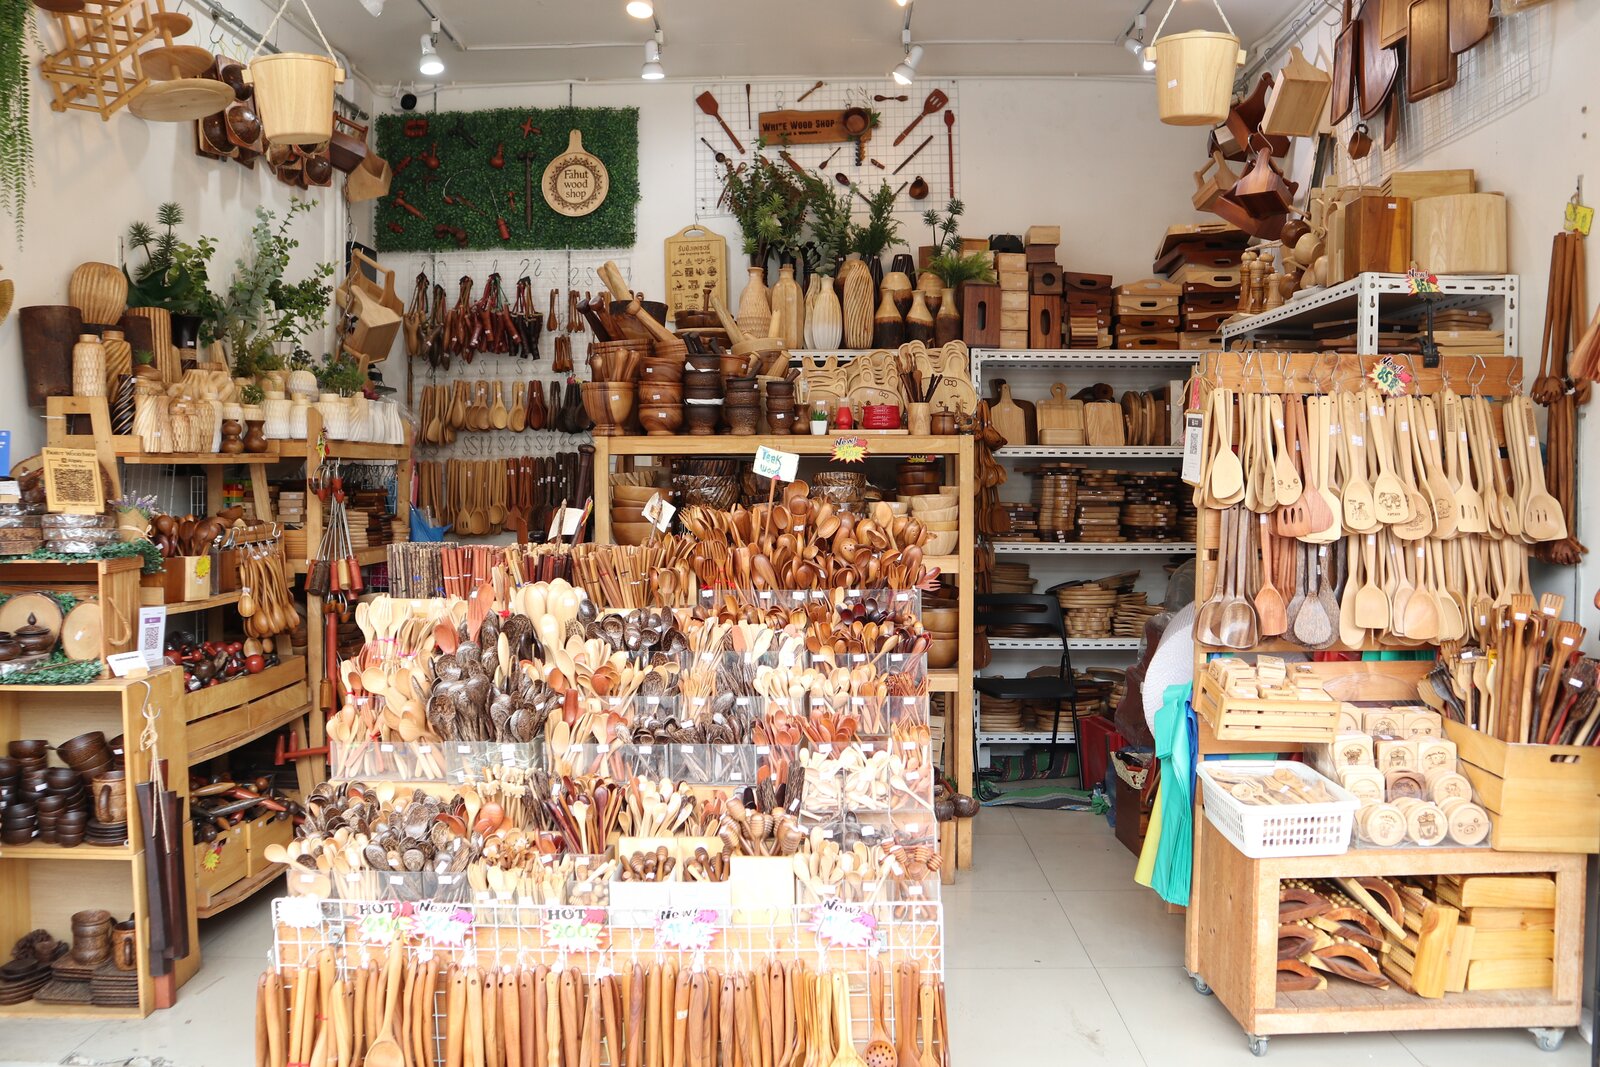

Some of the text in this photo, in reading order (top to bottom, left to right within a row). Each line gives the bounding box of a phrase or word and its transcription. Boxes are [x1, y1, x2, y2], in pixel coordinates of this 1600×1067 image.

[790, 121, 812, 130] WOOD
[815, 119, 835, 129] SHOP
[564, 169, 589, 179] Fahut
[564, 179, 588, 188] wood
[565, 189, 587, 200] shop
[835, 437, 858, 446] New!
[359, 903, 395, 914] HOT
[419, 901, 457, 913] New!
[548, 908, 586, 920] HOT
[660, 908, 698, 920] New!
